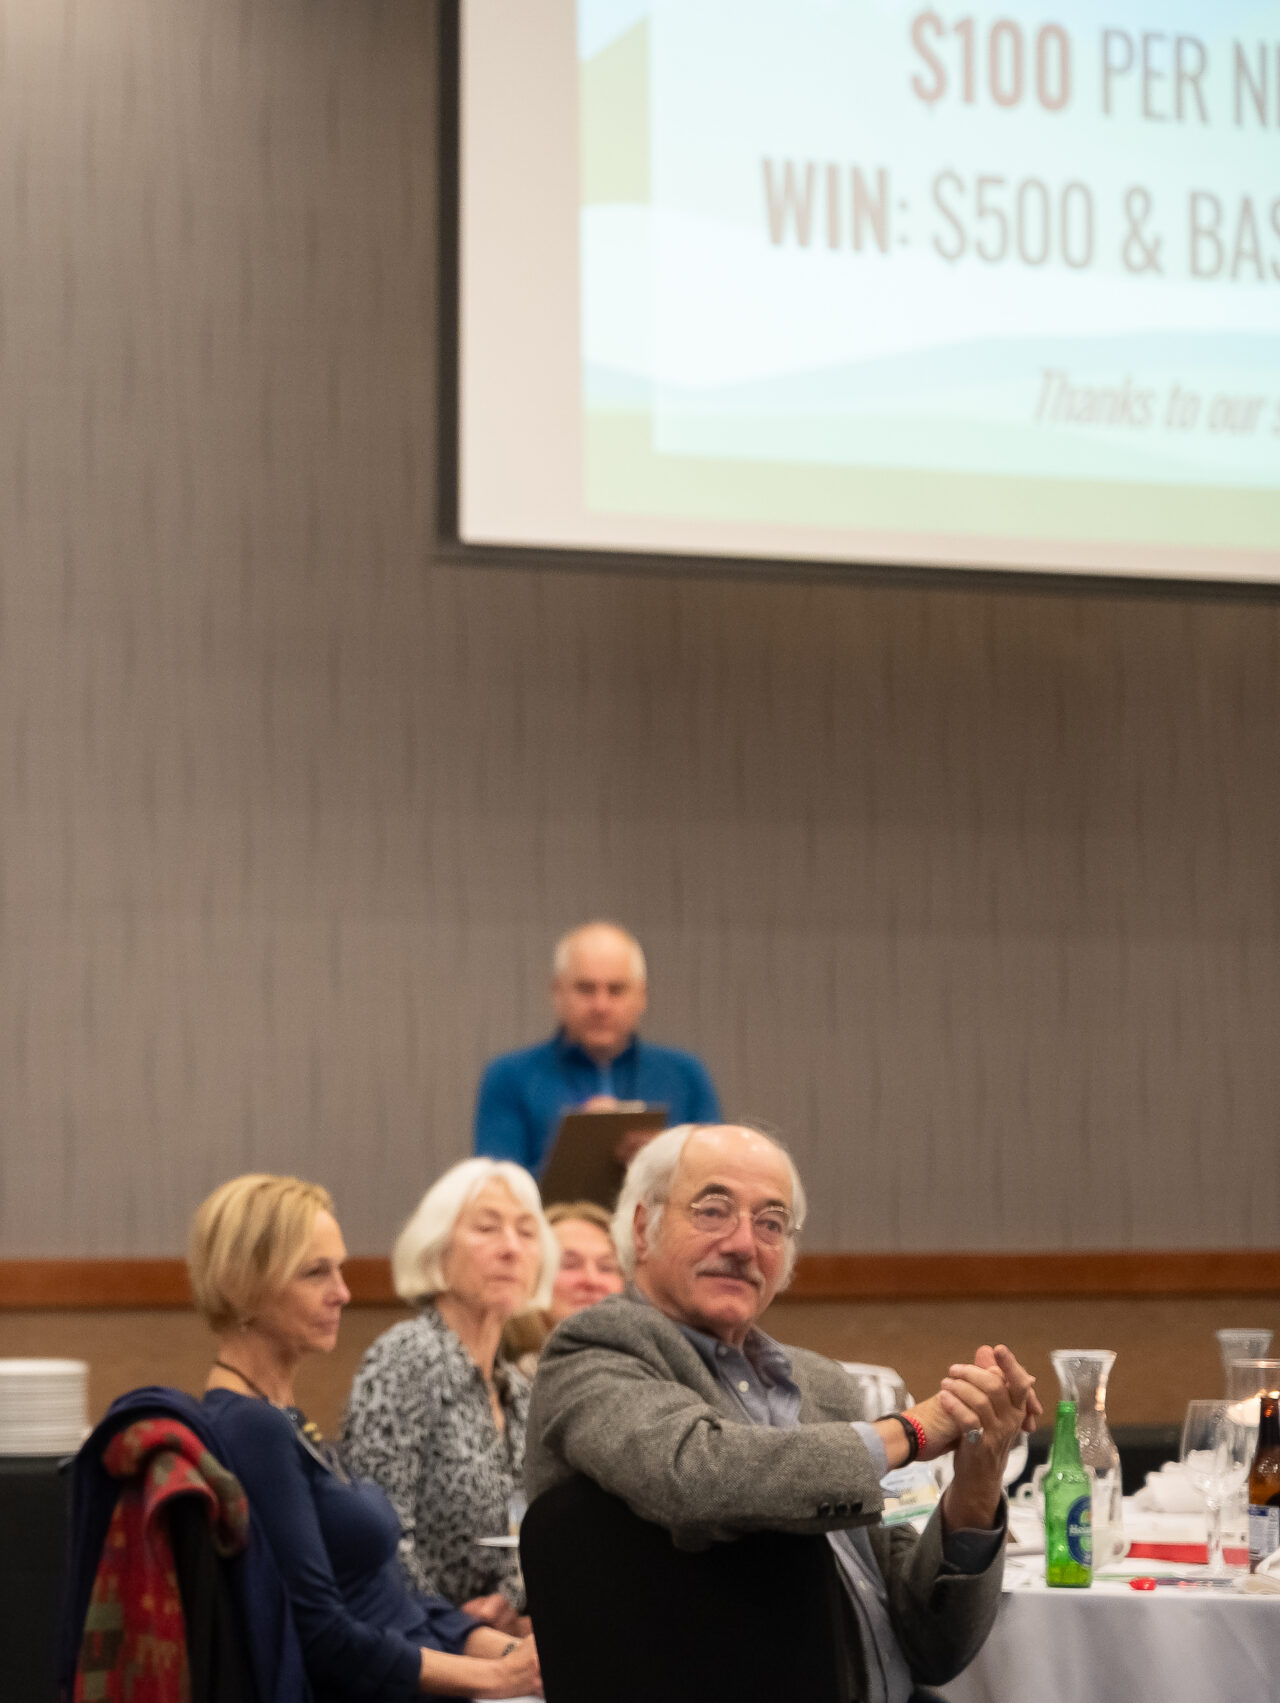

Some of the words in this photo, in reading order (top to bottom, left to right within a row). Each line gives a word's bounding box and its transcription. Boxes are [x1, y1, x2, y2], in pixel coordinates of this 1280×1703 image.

[910, 7, 1073, 112] $100
[1100, 27, 1209, 126] PER
[1231, 37, 1280, 131] N
[761, 155, 911, 254] WIN:
[931, 165, 1096, 270] $500
[1121, 185, 1164, 276] &
[1034, 367, 1156, 429] Thanks
[1164, 380, 1202, 432] to
[1207, 392, 1267, 437] our
